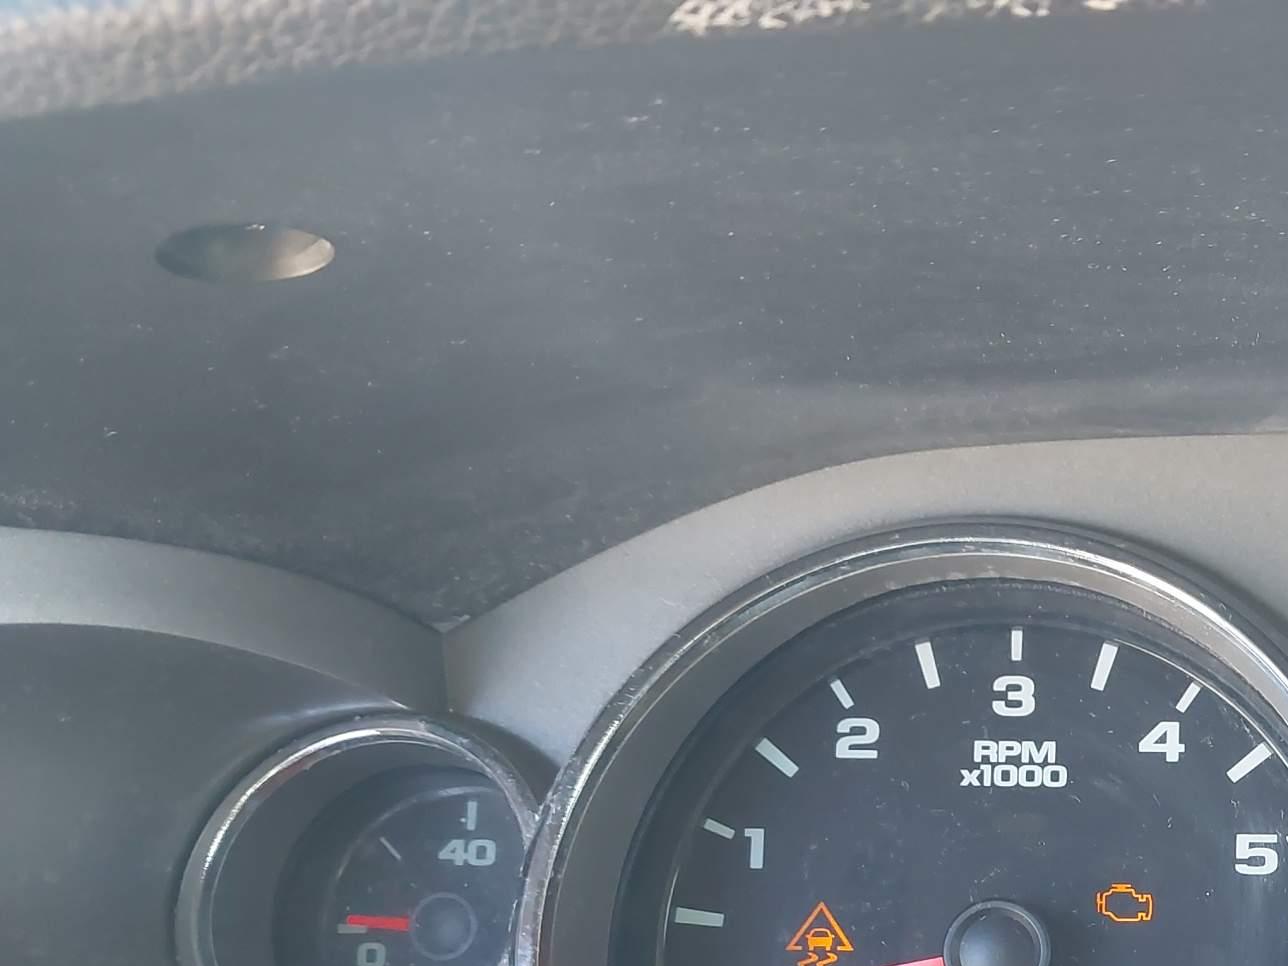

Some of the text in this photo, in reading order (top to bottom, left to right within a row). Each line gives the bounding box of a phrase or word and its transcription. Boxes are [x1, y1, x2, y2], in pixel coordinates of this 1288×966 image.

[991, 675, 1036, 717] 3
[835, 717, 879, 760] 2
[972, 740, 1057, 764] RPM
[1138, 721, 1186, 763] 4
[960, 765, 1068, 788] x1000
[437, 839, 497, 867] 40
[743, 828, 766, 869] 1
[1234, 834, 1279, 875] 5
